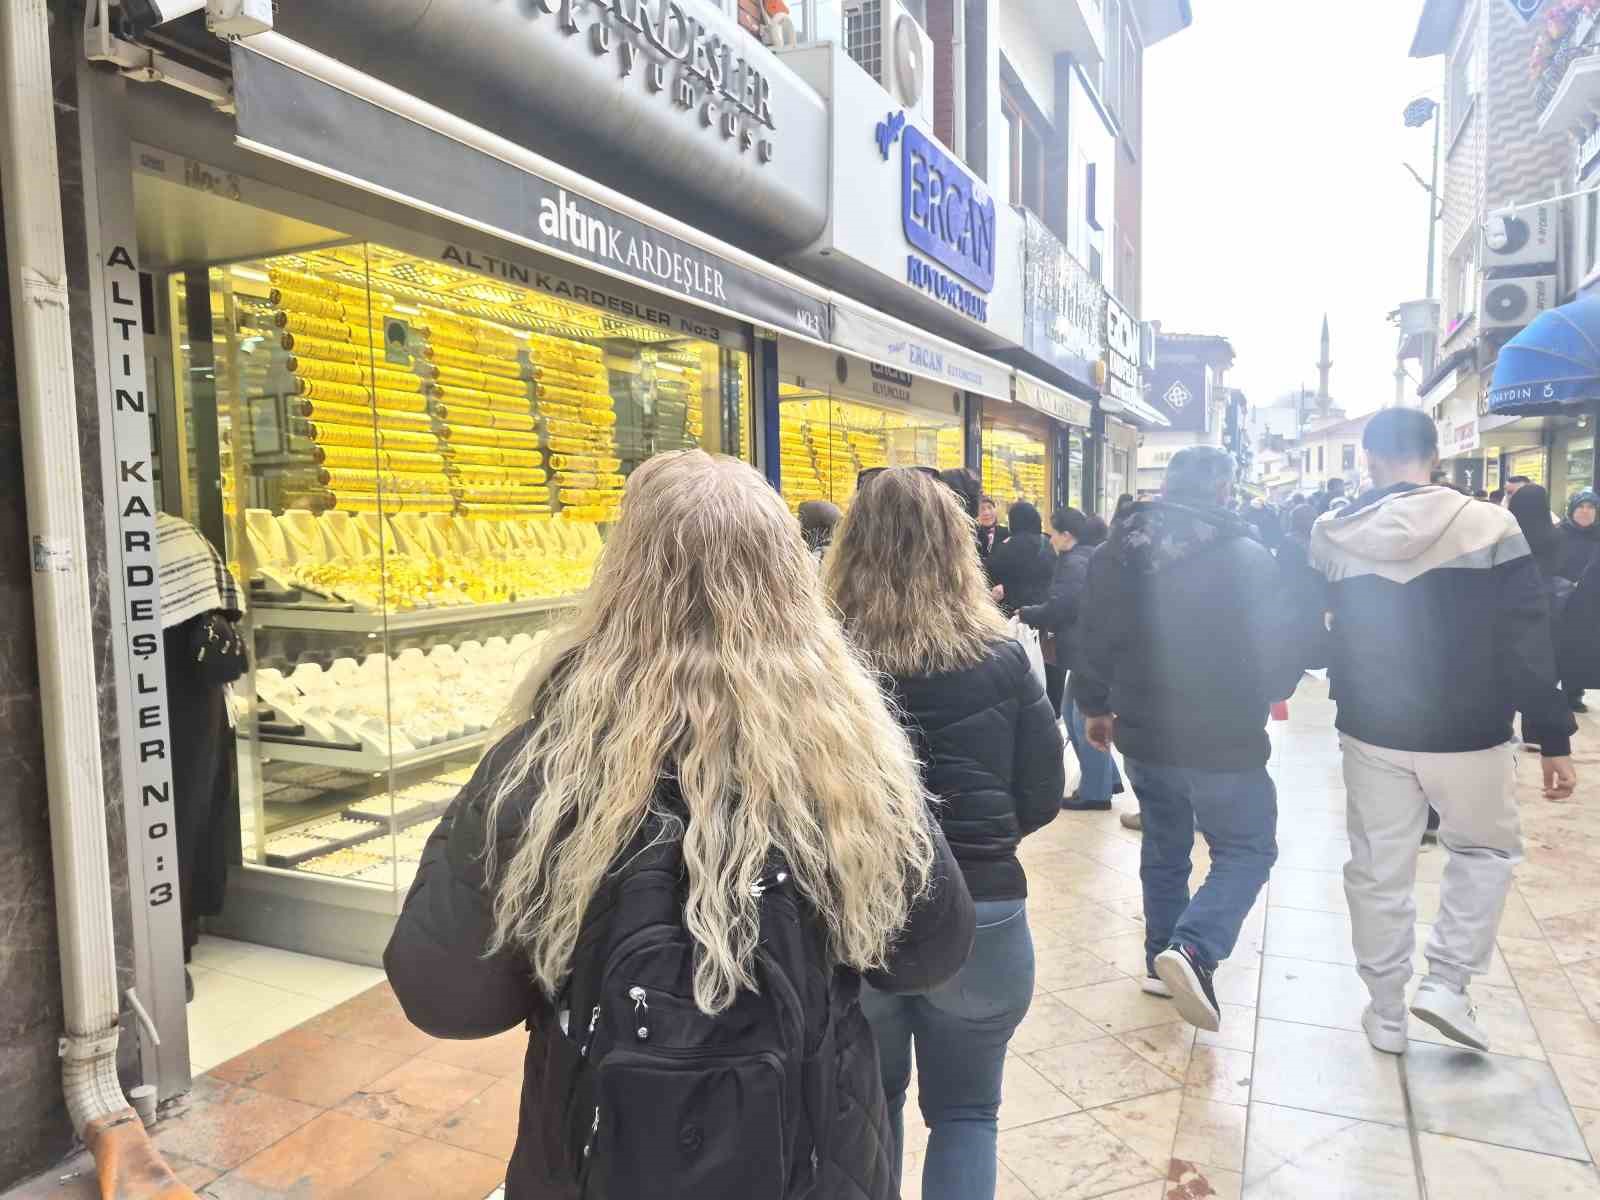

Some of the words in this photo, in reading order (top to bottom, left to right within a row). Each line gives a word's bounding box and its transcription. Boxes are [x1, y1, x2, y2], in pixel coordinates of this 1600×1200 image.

[909, 147, 993, 277] ERCAN
[107, 245, 145, 413] ALTIN
[441, 244, 529, 283] ALTIN
[680, 318, 721, 341] No:3
[908, 343, 944, 373] ERCAN
[119, 460, 167, 763] KARDEŞLER
